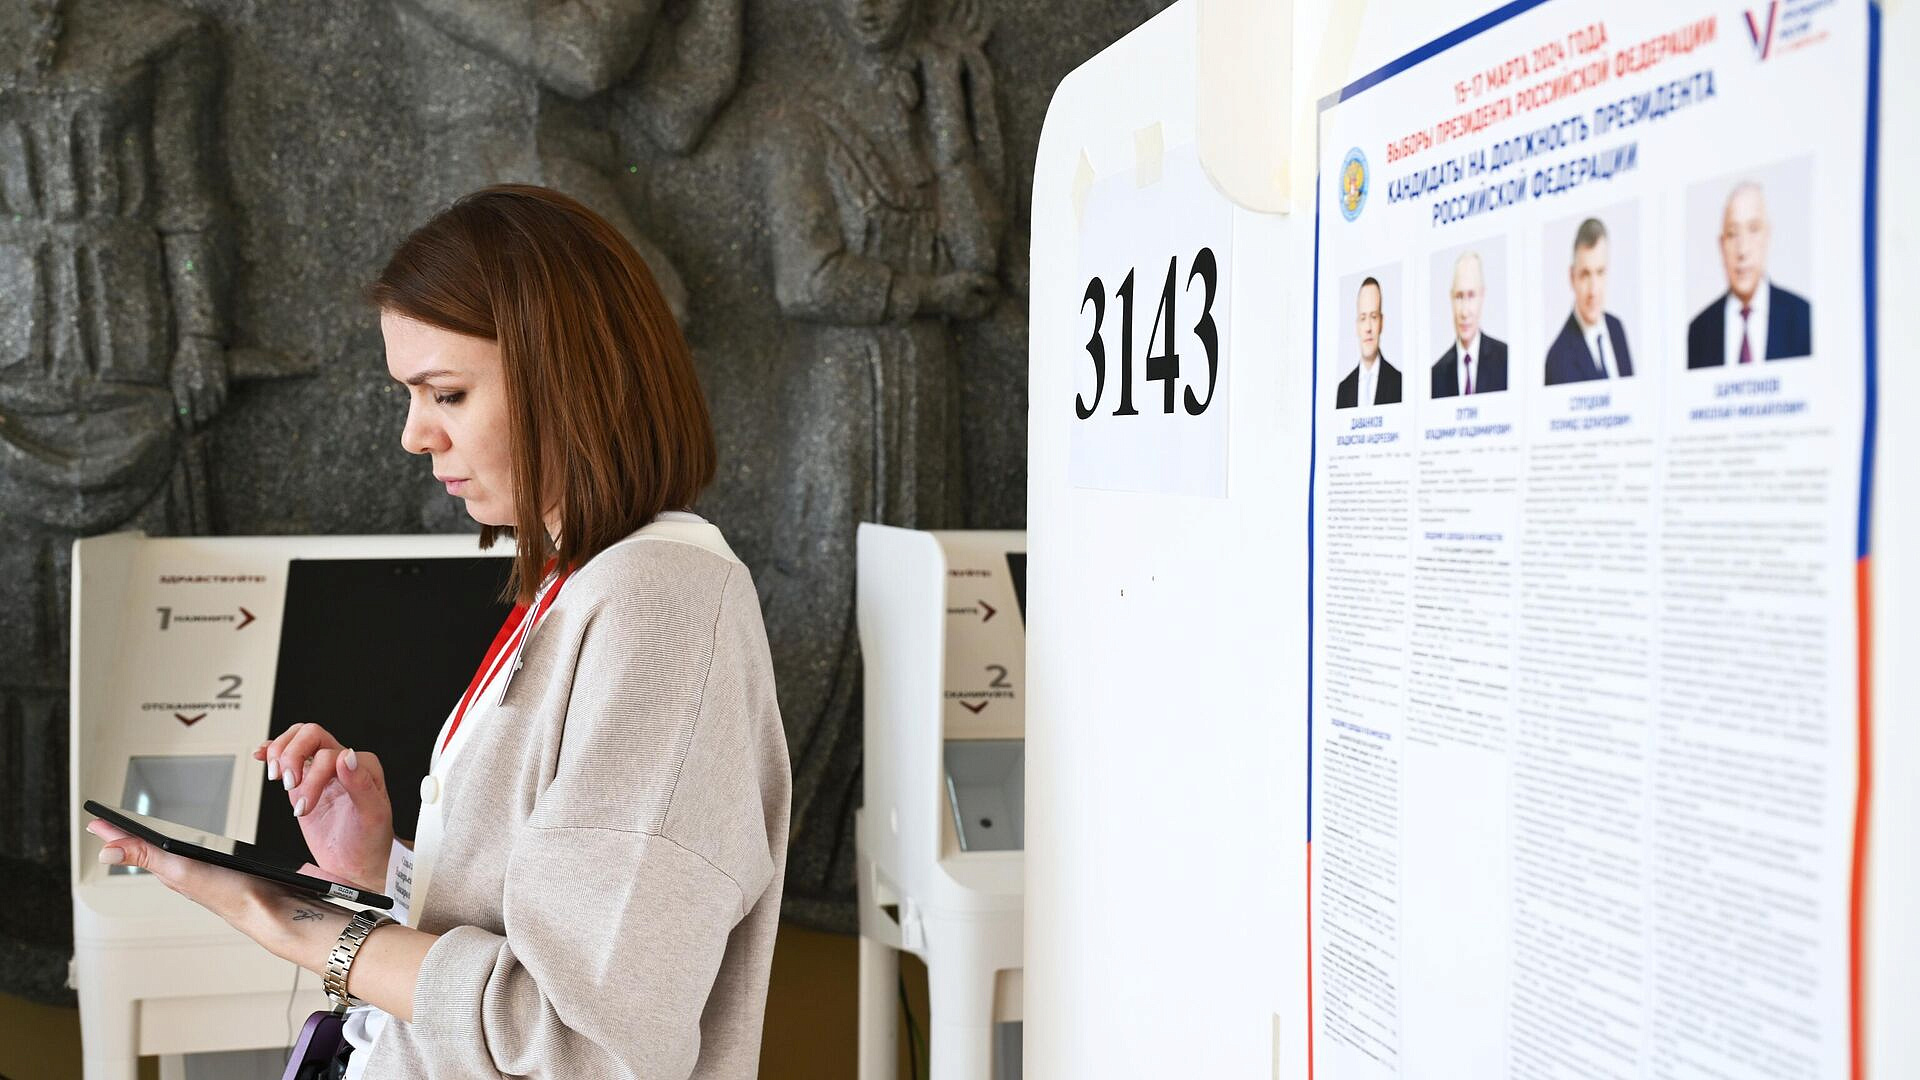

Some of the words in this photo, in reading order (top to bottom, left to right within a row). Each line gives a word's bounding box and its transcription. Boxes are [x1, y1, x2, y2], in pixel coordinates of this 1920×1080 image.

[1387, 128, 1433, 164] ВЫБОРЫ
[1436, 98, 1513, 140] ПРЕЗИДЕНТА
[1515, 58, 1611, 113] РОССИЙСКОЙ
[1615, 14, 1718, 79] ФЕДЕРАЦИИ
[1486, 55, 1530, 90] МАРТА
[1533, 40, 1565, 75] 2024
[1568, 20, 1609, 57] ГОДА
[1387, 156, 1466, 205] КАНДИДАТЫ
[1468, 149, 1487, 176] НА
[1490, 115, 1589, 173] ДОЛЖНОСТЬ
[1593, 68, 1717, 137] ПРЕЗИДЕНТА
[1432, 168, 1529, 228] РОССИЙСКОЙ
[1532, 141, 1639, 199] ФЕДЕРАЦИИ
[1075, 247, 1219, 420] 3143
[156, 606, 172, 631] 1
[141, 702, 241, 711] ОТСКАНИРУЙТЕ
[216, 673, 243, 699] 2
[985, 664, 1012, 689] 2
